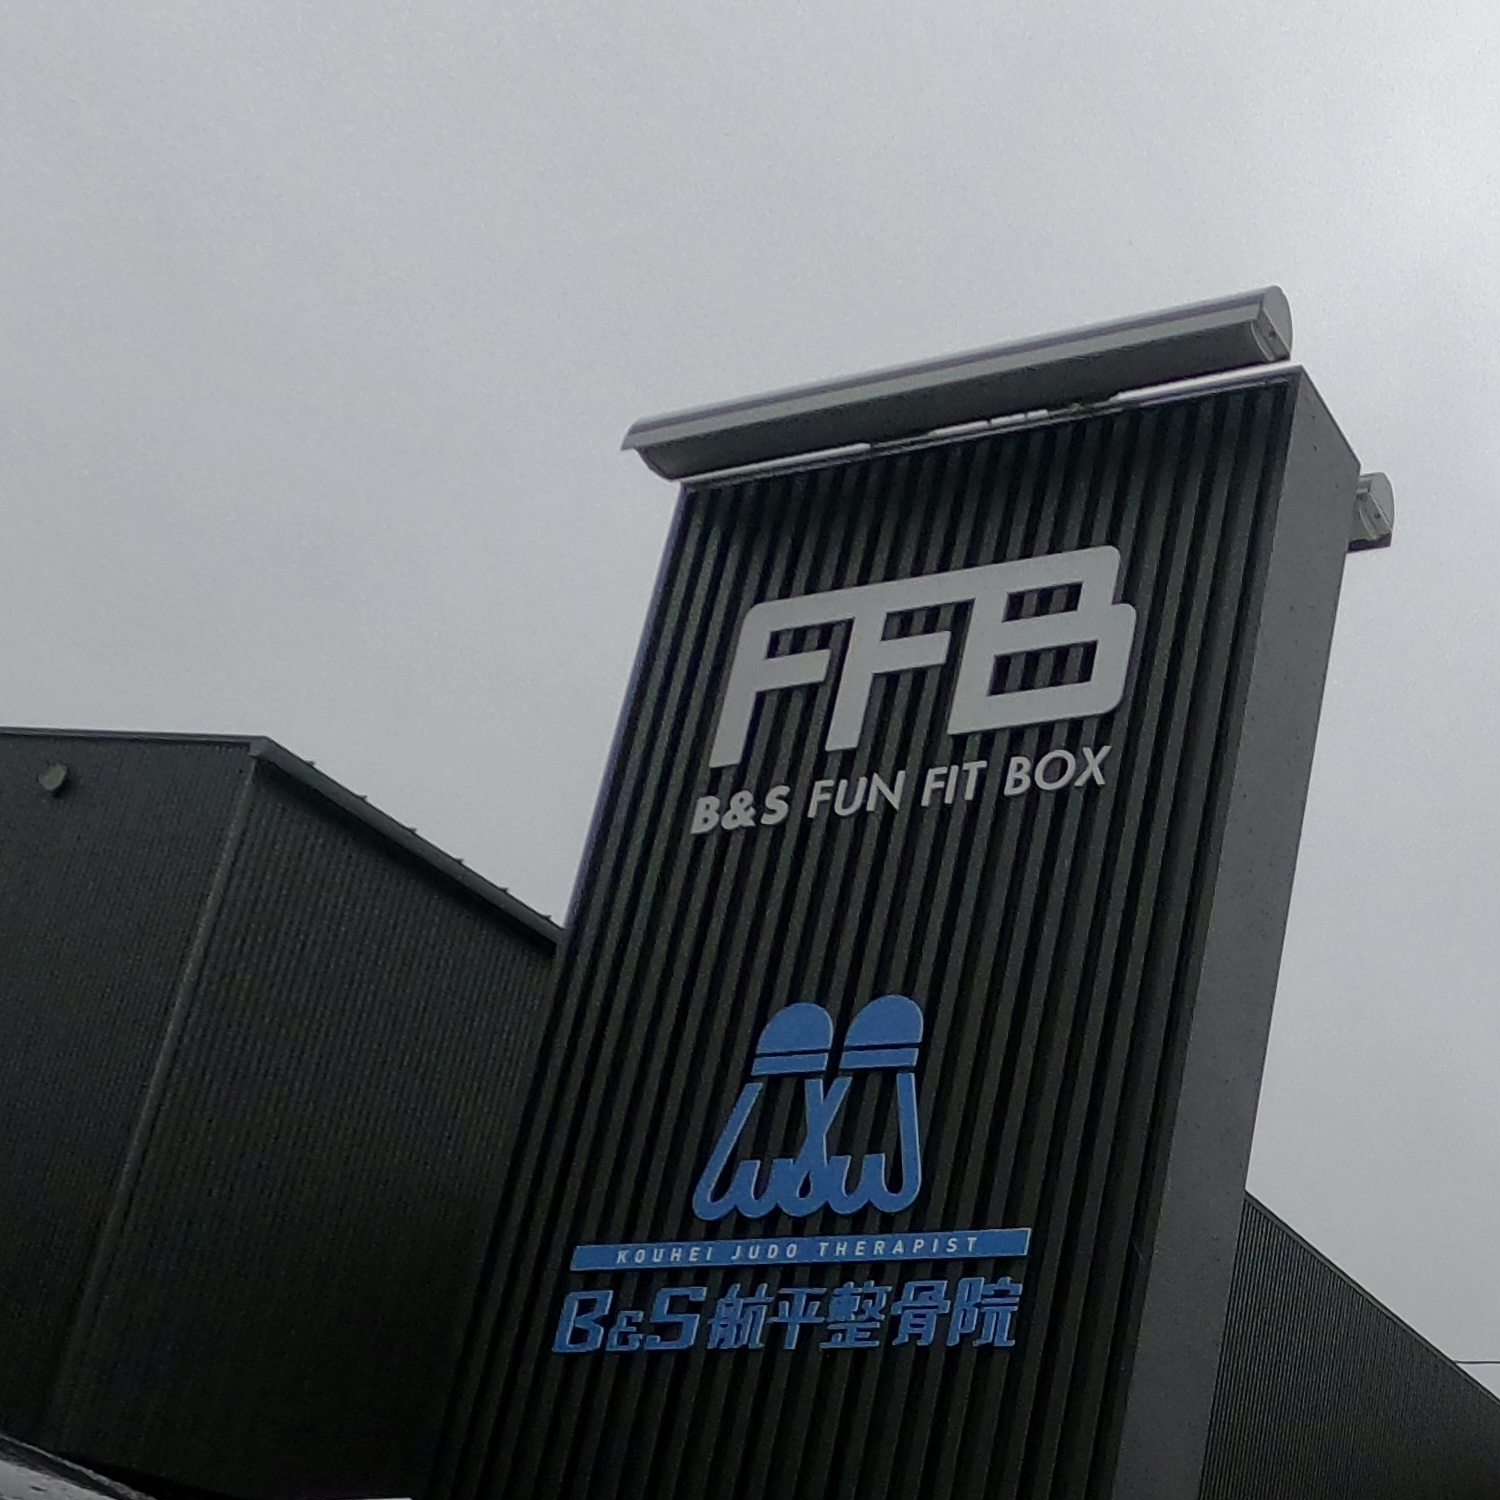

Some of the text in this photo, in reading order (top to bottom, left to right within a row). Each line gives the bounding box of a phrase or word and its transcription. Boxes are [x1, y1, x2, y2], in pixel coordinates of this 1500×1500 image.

[709, 545, 1137, 768] FFB
[691, 745, 1112, 834] B&S FUN FIT BOX
[616, 1236, 979, 1264] KOUHEI JUDO THERAPIST
